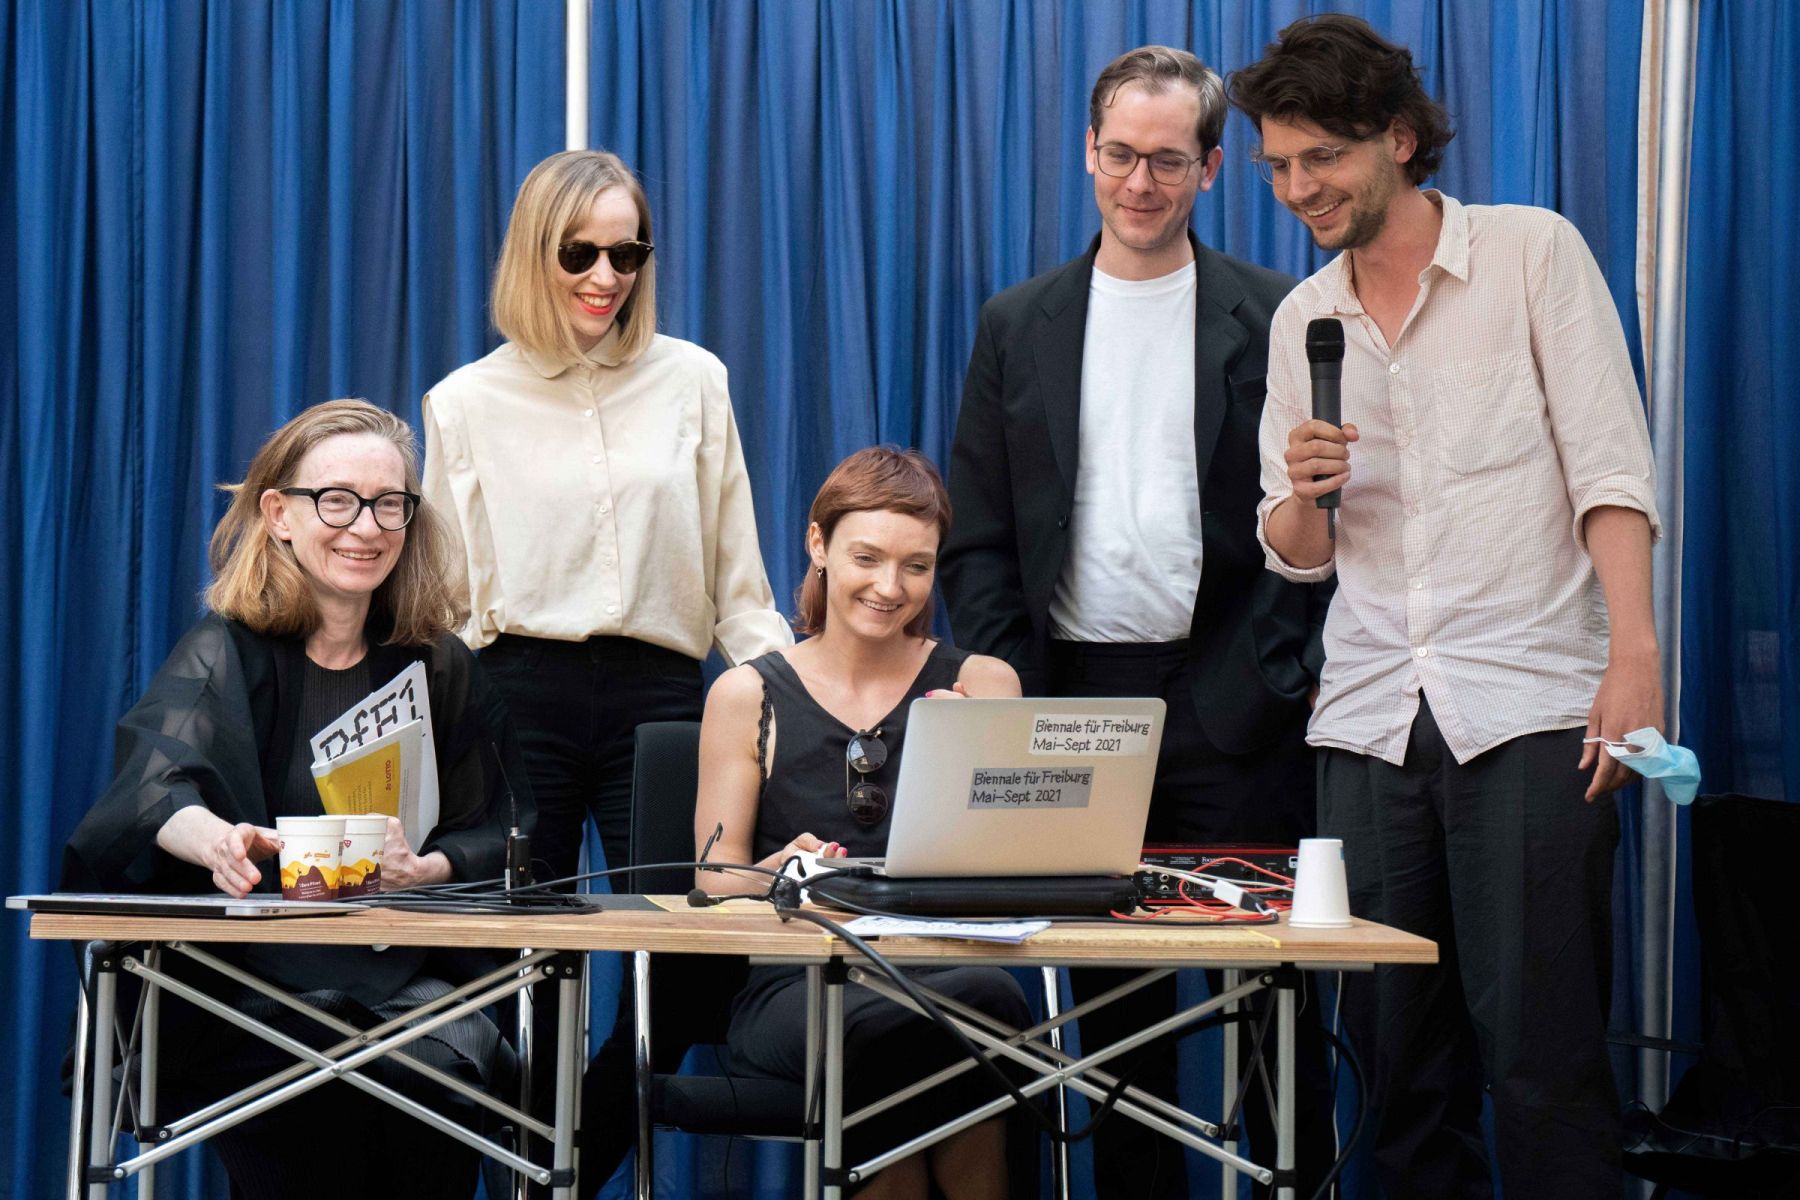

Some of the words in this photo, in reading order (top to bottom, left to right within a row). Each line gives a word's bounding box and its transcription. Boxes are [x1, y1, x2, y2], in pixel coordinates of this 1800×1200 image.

[1035, 718, 1082, 733] Biennale
[1084, 719, 1101, 734] für
[1102, 719, 1151, 735] Freiburg
[1095, 738, 1121, 751] 2021
[974, 772, 1021, 786] Biennale
[1023, 771, 1040, 785] für
[1042, 769, 1091, 785] Freiburg
[1035, 789, 1061, 802] 2021
